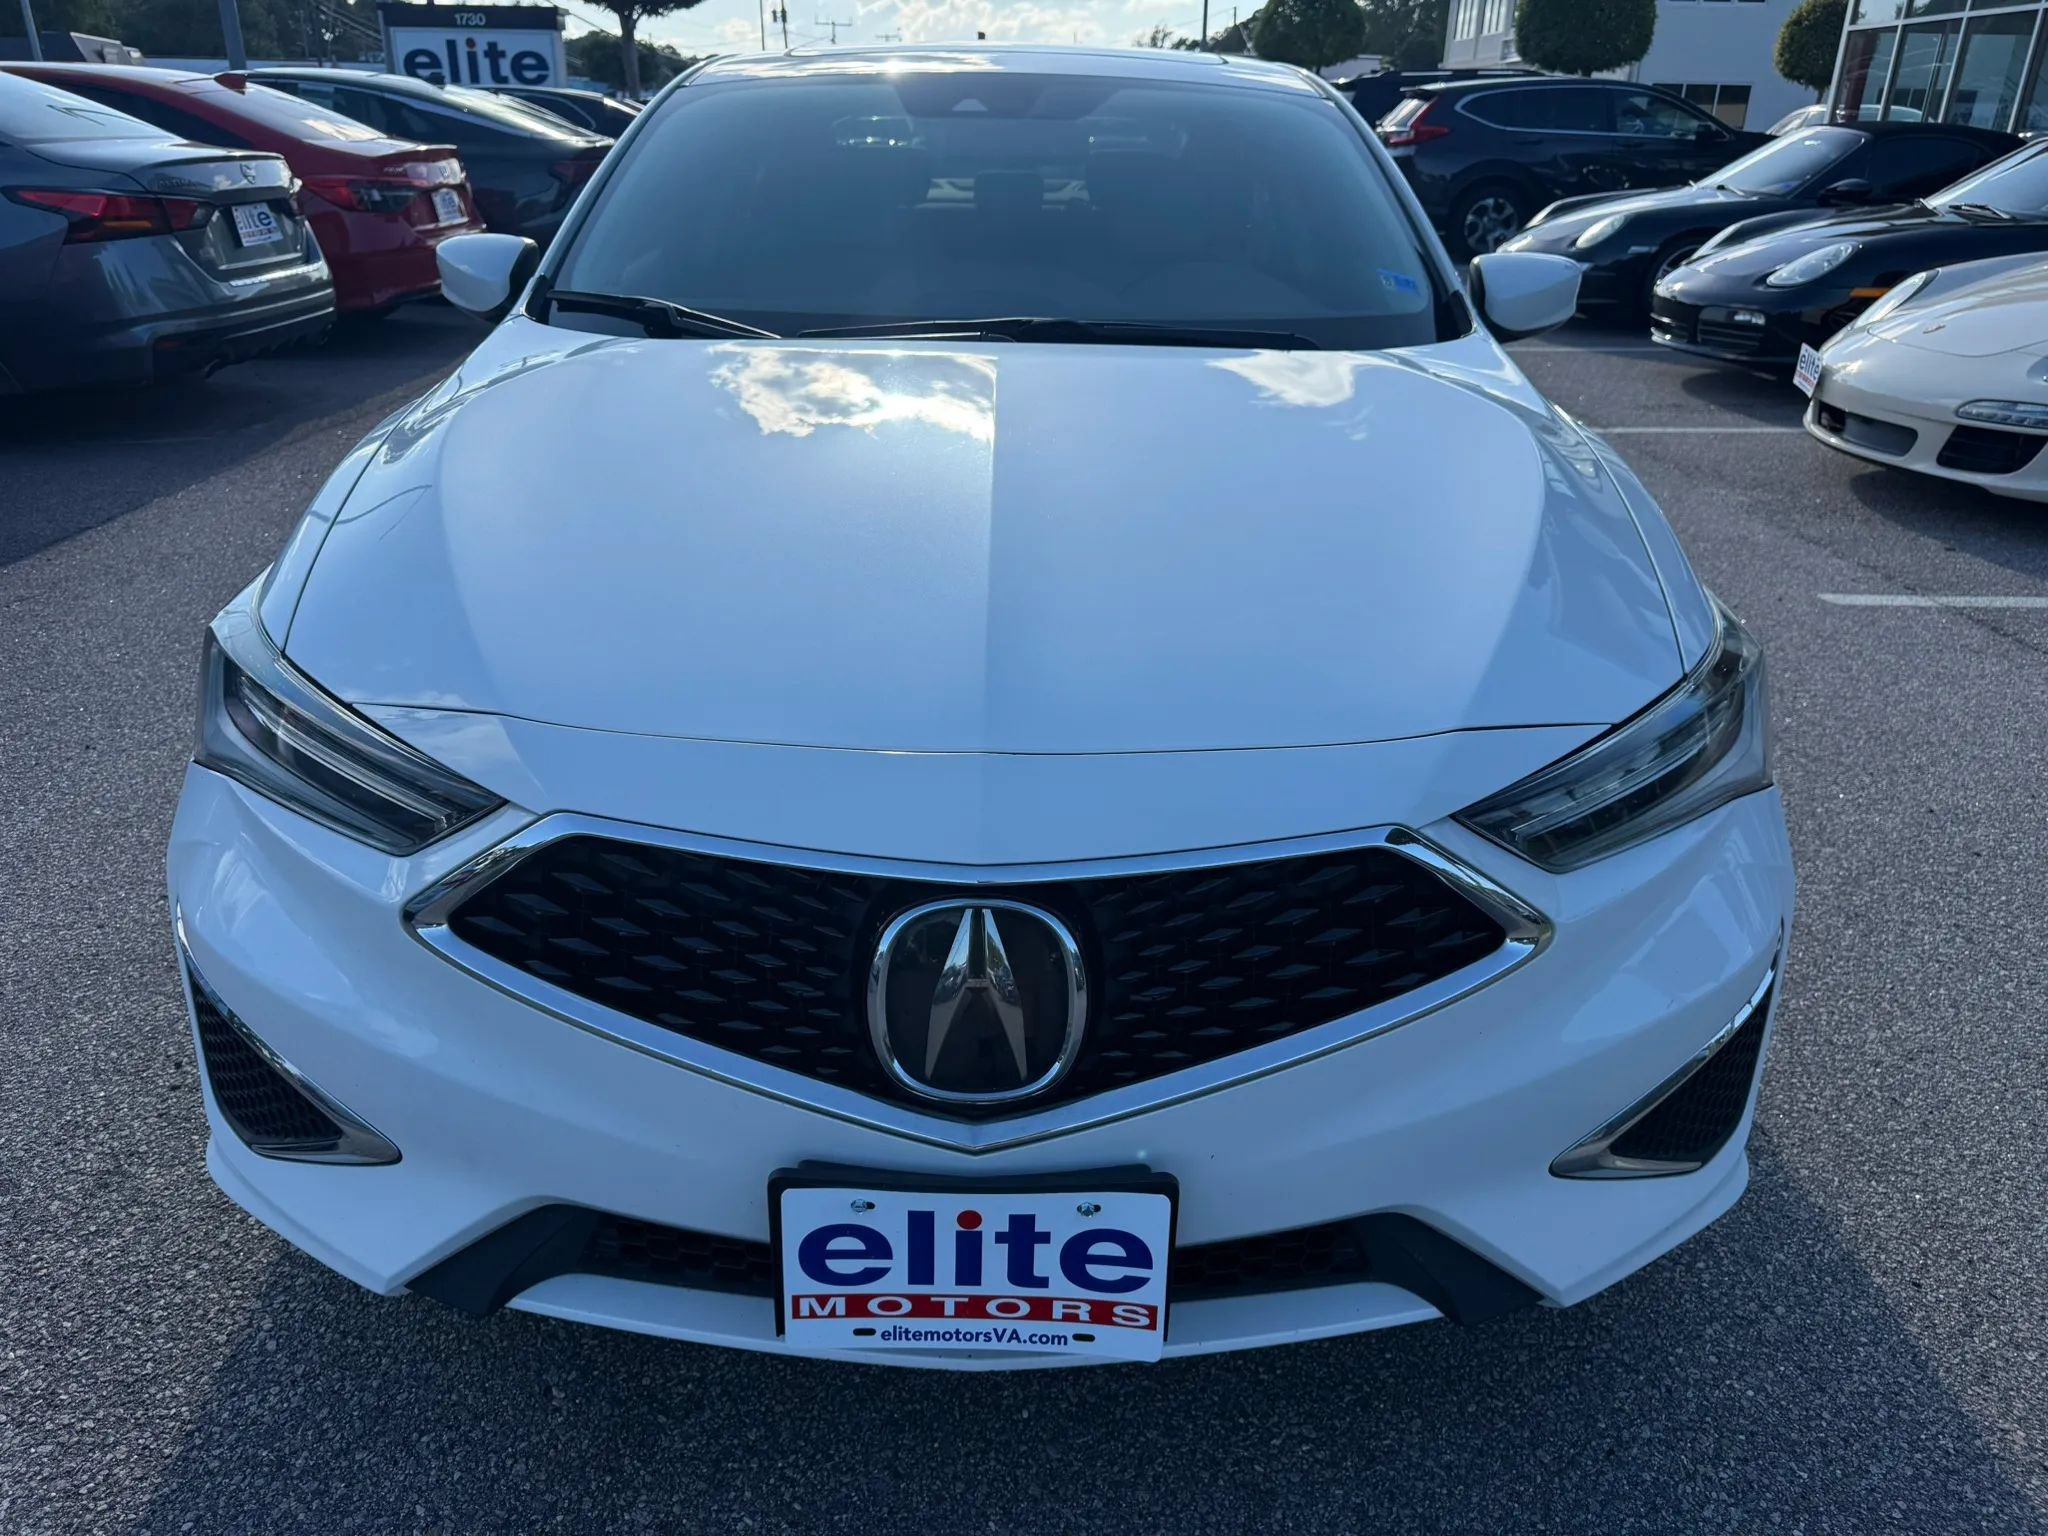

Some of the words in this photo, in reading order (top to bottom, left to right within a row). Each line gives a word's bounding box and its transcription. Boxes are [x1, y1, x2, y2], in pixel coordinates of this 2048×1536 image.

[454, 13, 487, 26] 1730
[403, 37, 550, 86] elite
[798, 1210, 1154, 1294] elite
[799, 1296, 1151, 1328] MOTORS
[880, 1325, 1069, 1346] elitemotorsVA.com
